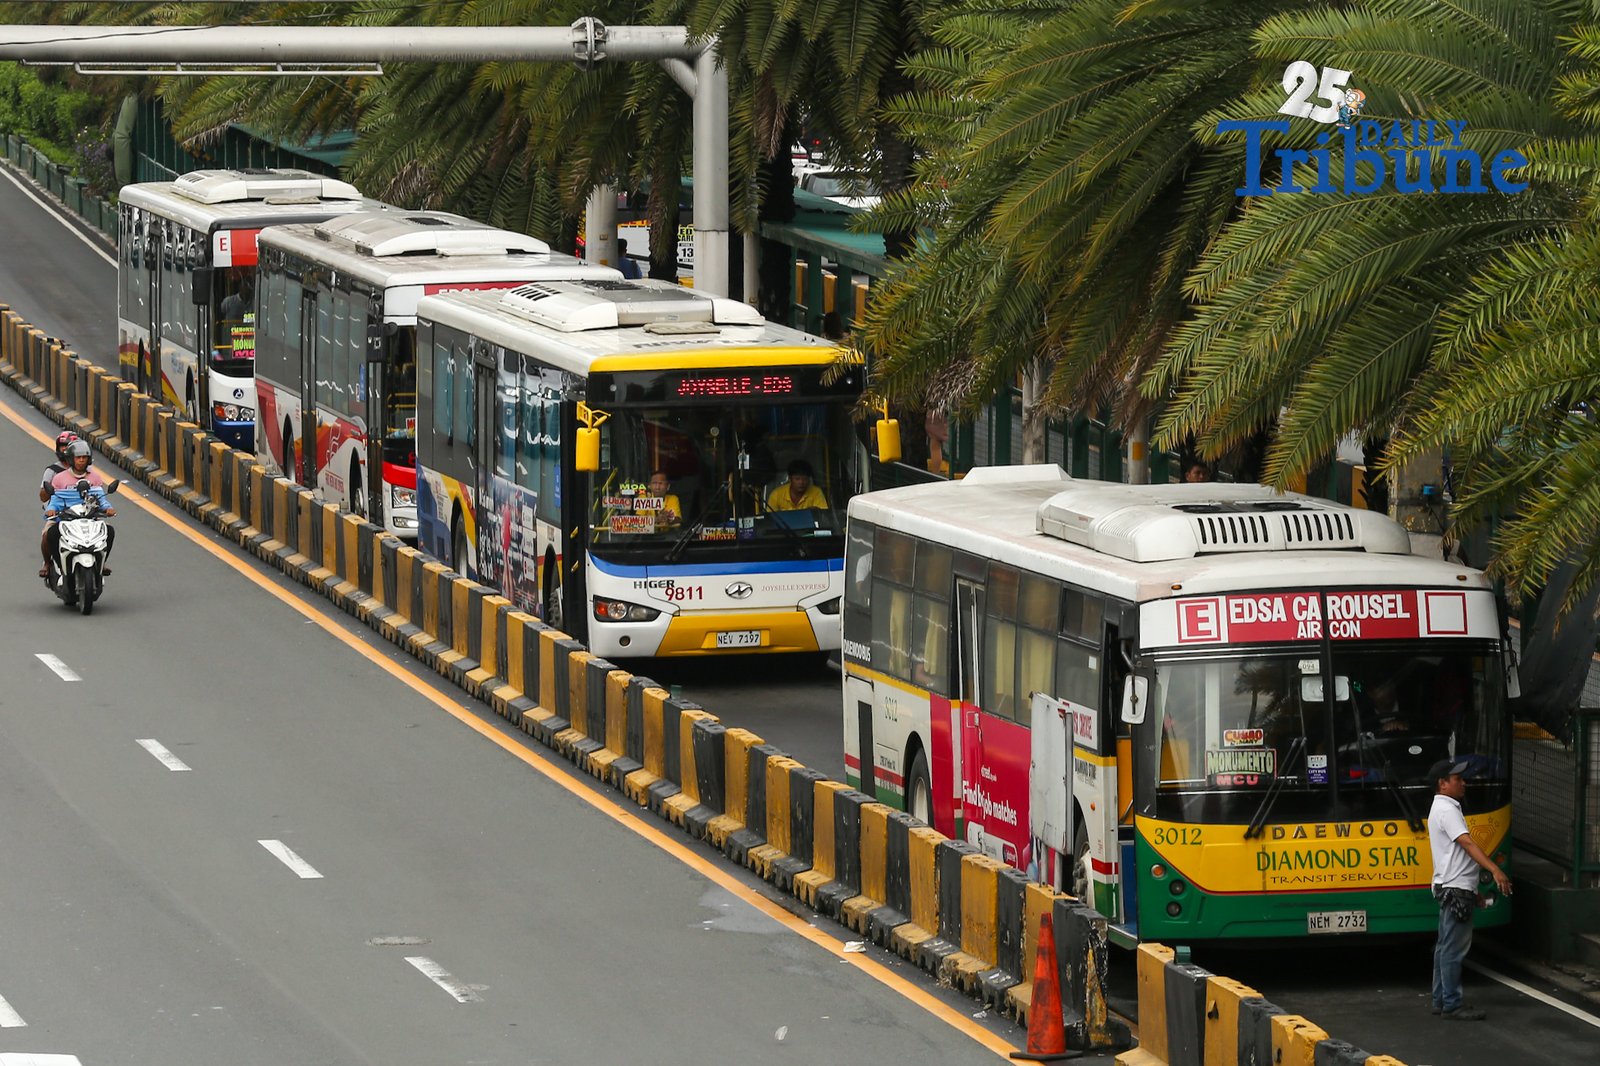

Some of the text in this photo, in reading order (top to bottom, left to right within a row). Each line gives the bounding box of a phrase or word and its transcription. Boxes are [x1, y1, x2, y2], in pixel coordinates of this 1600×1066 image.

[219, 237, 228, 252] E
[634, 499, 663, 510] AYALA
[633, 579, 676, 590] HIGER
[761, 583, 827, 592] JOYSELLE EXPRESS
[664, 586, 704, 602] 9811
[1229, 597, 1287, 624] EDSA
[1184, 600, 1213, 638] E
[1296, 620, 1361, 639] AIR CON
[717, 633, 760, 645] NEV 7197
[1207, 751, 1274, 776] MONUMENTO
[1216, 774, 1259, 786] MCU
[993, 800, 1018, 827] matches
[1154, 827, 1203, 846] 3012
[1272, 822, 1399, 840] DAEWOO
[1256, 846, 1420, 872] DIAMOND STAR
[1270, 871, 1409, 884] TRANSIT SERVICES
[1309, 915, 1366, 929] NEM 2732
